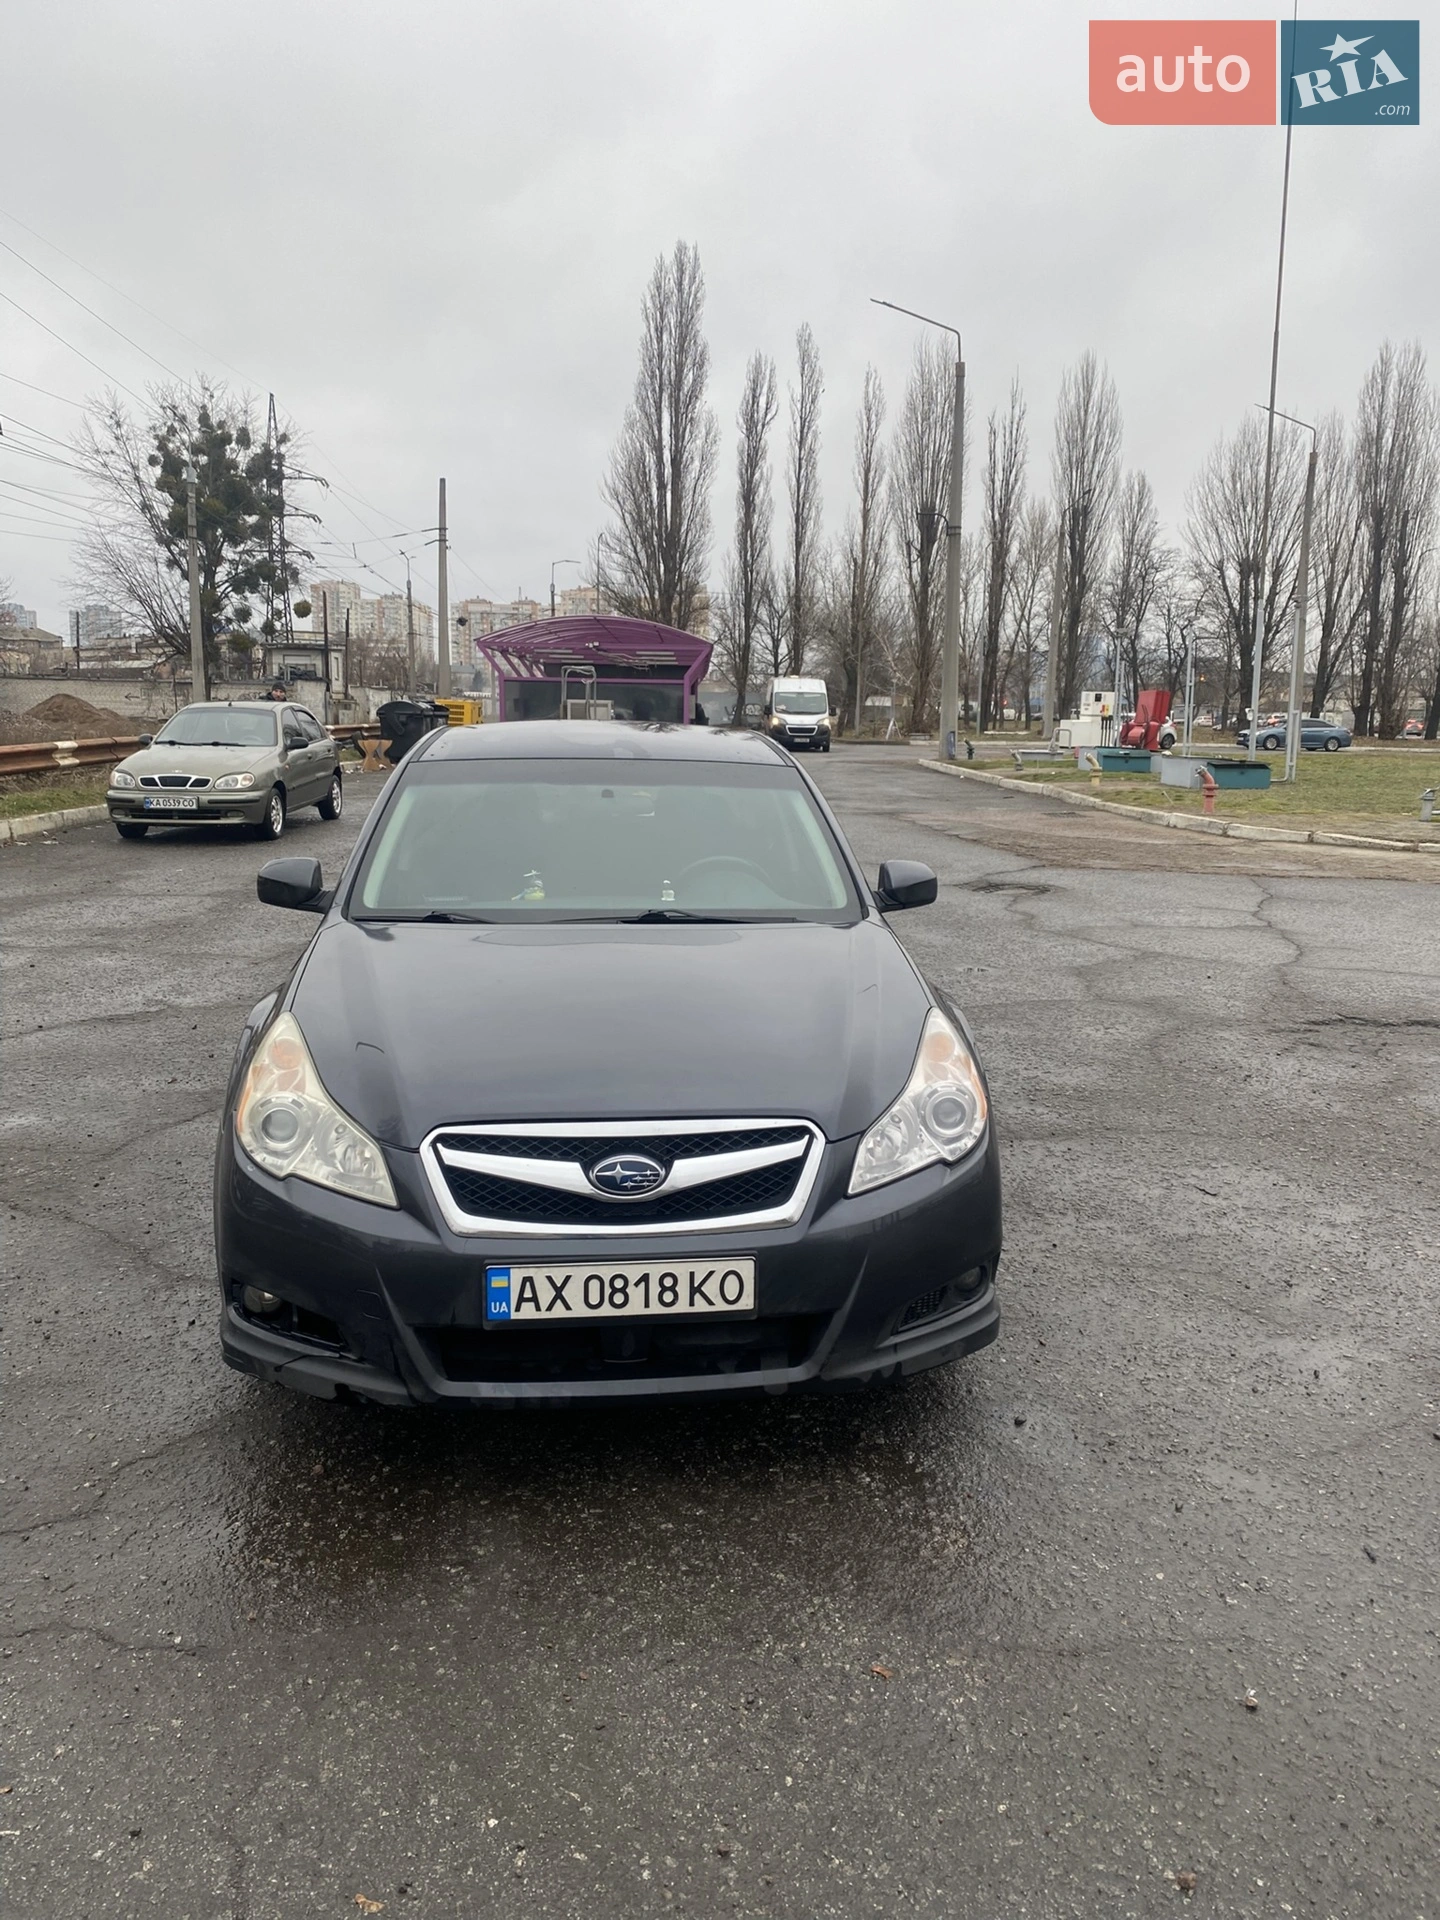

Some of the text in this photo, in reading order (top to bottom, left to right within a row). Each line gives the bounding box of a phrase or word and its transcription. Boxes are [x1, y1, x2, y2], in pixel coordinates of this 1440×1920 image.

[150, 799, 194, 808] KA 0539 CO
[514, 1269, 744, 1312] AX 0818 KO
[491, 1301, 508, 1313] UA
